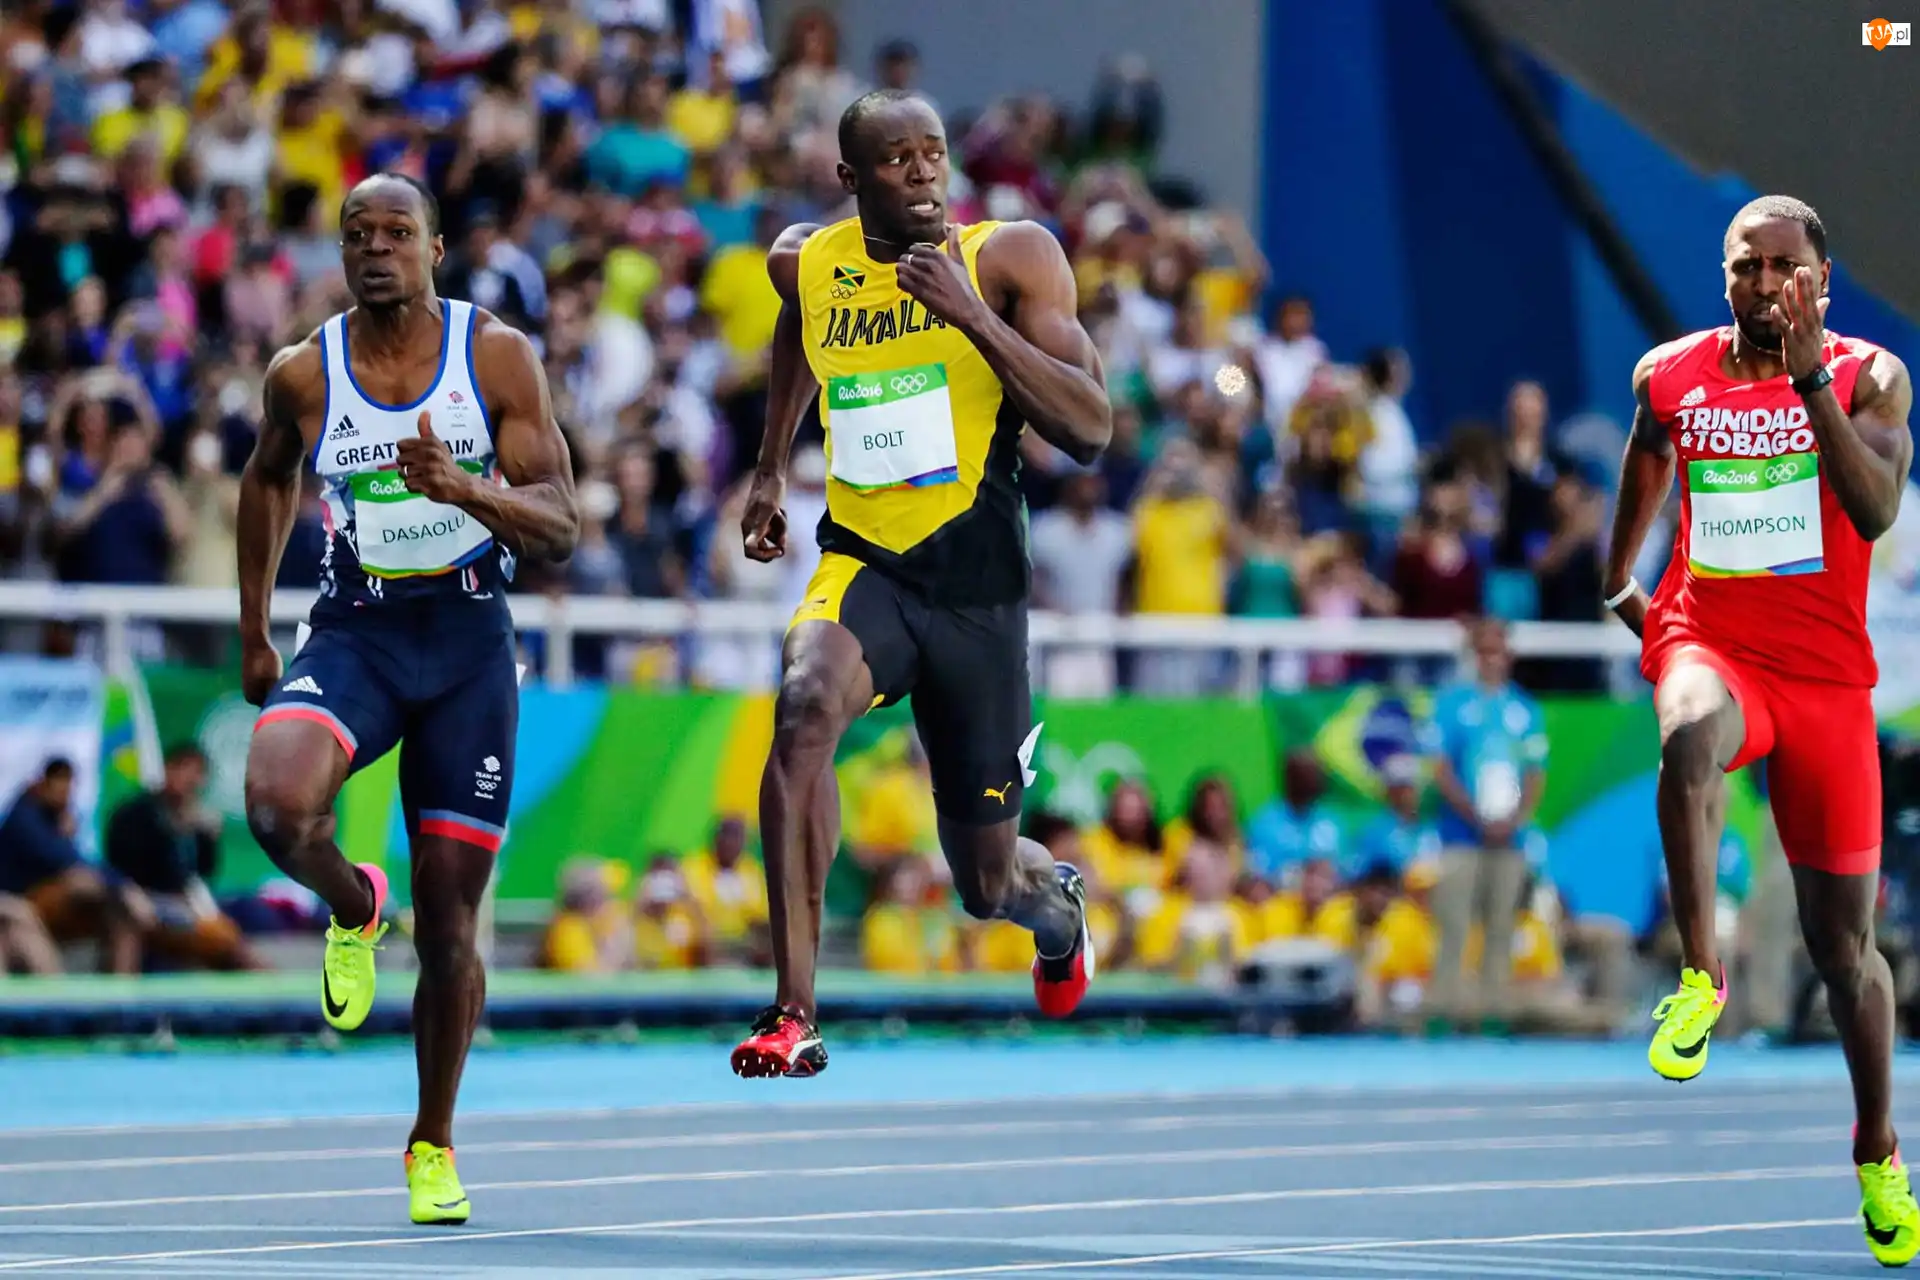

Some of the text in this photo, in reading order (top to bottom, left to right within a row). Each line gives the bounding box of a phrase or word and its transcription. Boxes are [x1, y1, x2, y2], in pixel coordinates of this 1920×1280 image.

[821, 299, 946, 348] JAMAICA
[838, 382, 883, 401] Rio2016
[1675, 404, 1810, 433] TRINIDAD
[329, 429, 360, 441] adidas
[863, 430, 905, 451] BOLT
[336, 442, 396, 467] GREAT
[1702, 469, 1758, 485] Rio2016
[382, 513, 466, 544] DASAOLU
[1700, 515, 1806, 537] THOMPSON
